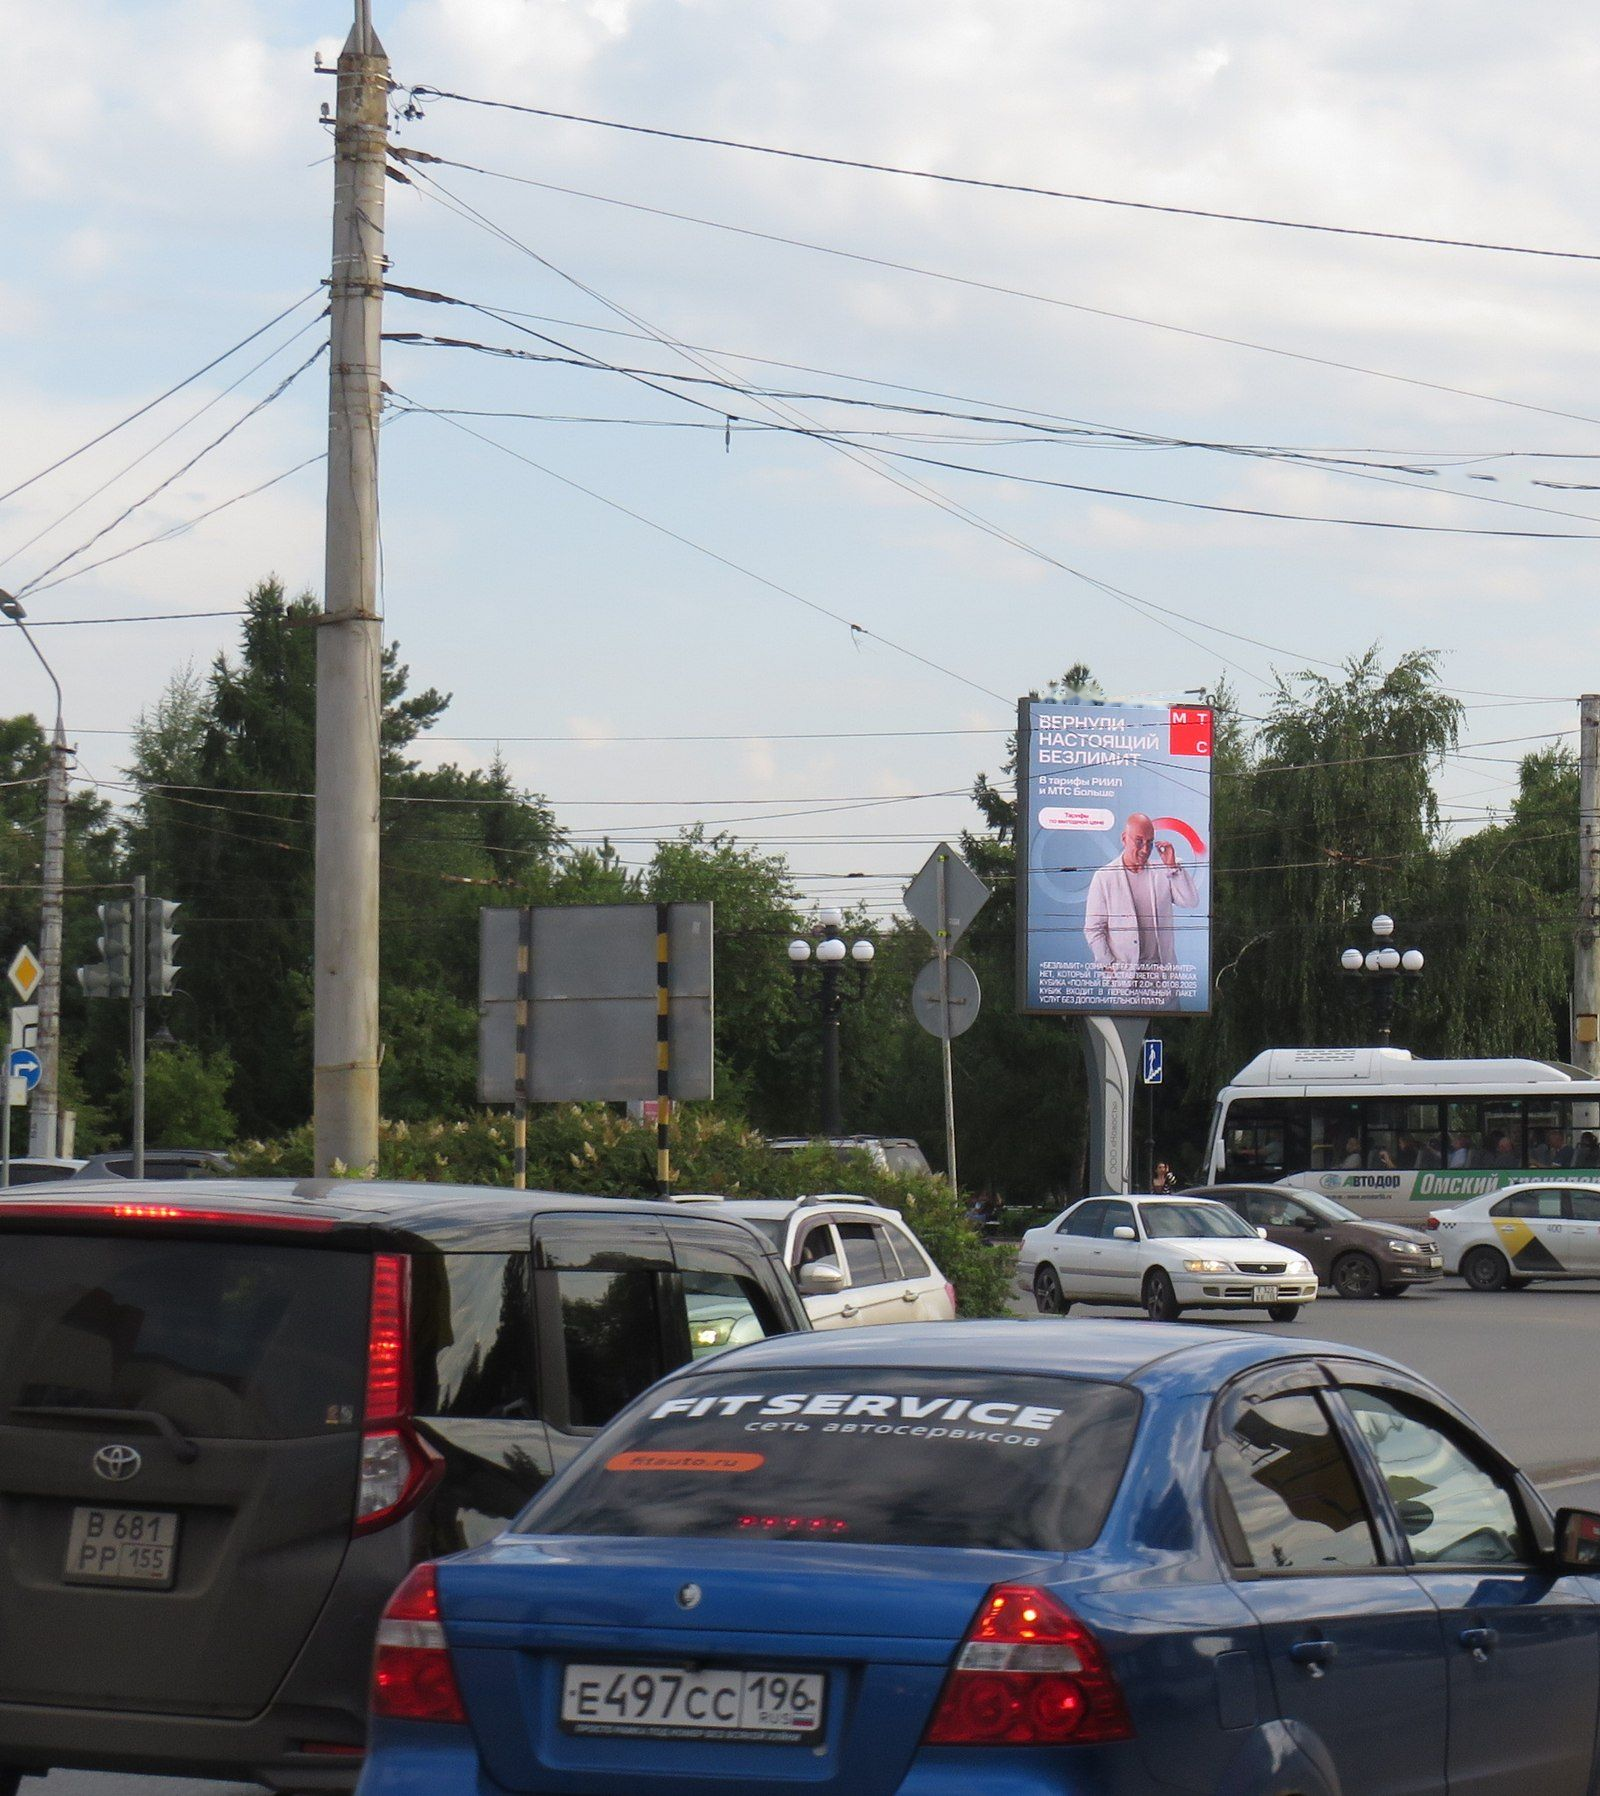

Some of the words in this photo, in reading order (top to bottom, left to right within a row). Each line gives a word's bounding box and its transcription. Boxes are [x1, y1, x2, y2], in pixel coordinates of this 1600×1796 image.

[1039, 715, 1125, 731] ВЕРНУЛИ
[1039, 733, 1160, 751] НАСТОЯЩИЙ
[1039, 750, 1141, 766] БЕЗЛИМИТ
[1039, 776, 1047, 784] В
[1049, 777, 1090, 787] тарифы
[1091, 778, 1123, 787] РИИЛ
[1047, 787, 1072, 796] МТС
[1073, 787, 1115, 797] Больше
[1110, 1149, 1118, 1174] ООО
[649, 1395, 765, 1420] FIT
[758, 1394, 1064, 1430] SERVICE
[744, 1420, 811, 1432] сеть
[822, 1422, 1042, 1447] автосервисов
[87, 1511, 105, 1538] В
[114, 1513, 161, 1542] 681
[78, 1544, 117, 1571] РР
[129, 1547, 163, 1569] 155
[577, 1673, 737, 1721] Е497СС
[748, 1676, 810, 1712] 196
[758, 1711, 791, 1726] RUS
